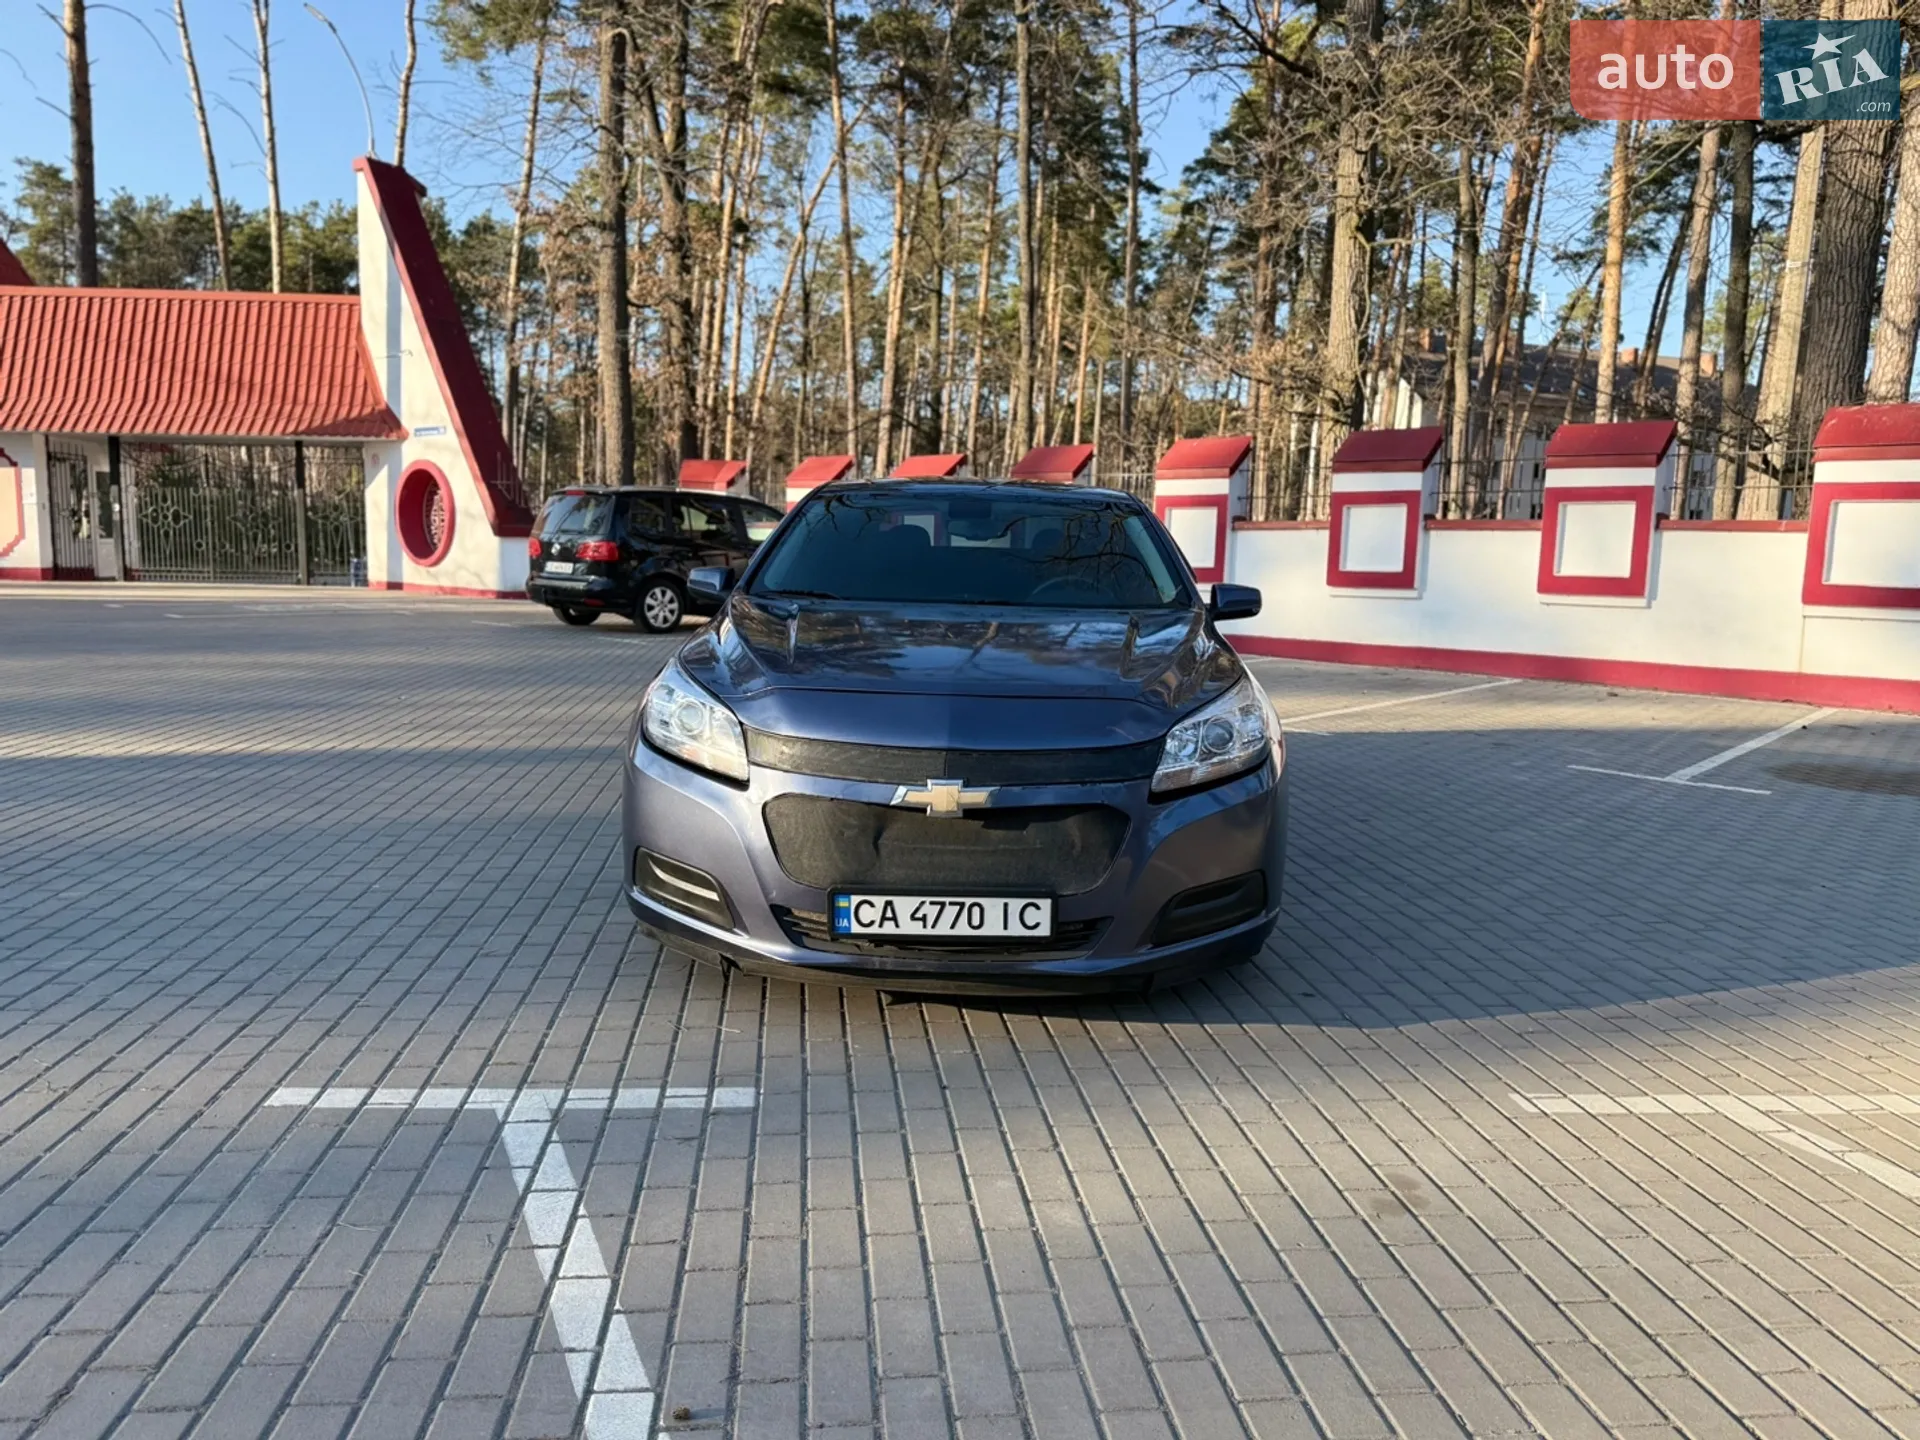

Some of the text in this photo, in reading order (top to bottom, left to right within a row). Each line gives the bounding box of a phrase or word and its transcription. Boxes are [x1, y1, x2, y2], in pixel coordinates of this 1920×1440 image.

[835, 917, 849, 927] UA
[853, 899, 900, 928] CA
[909, 900, 985, 930] 4770
